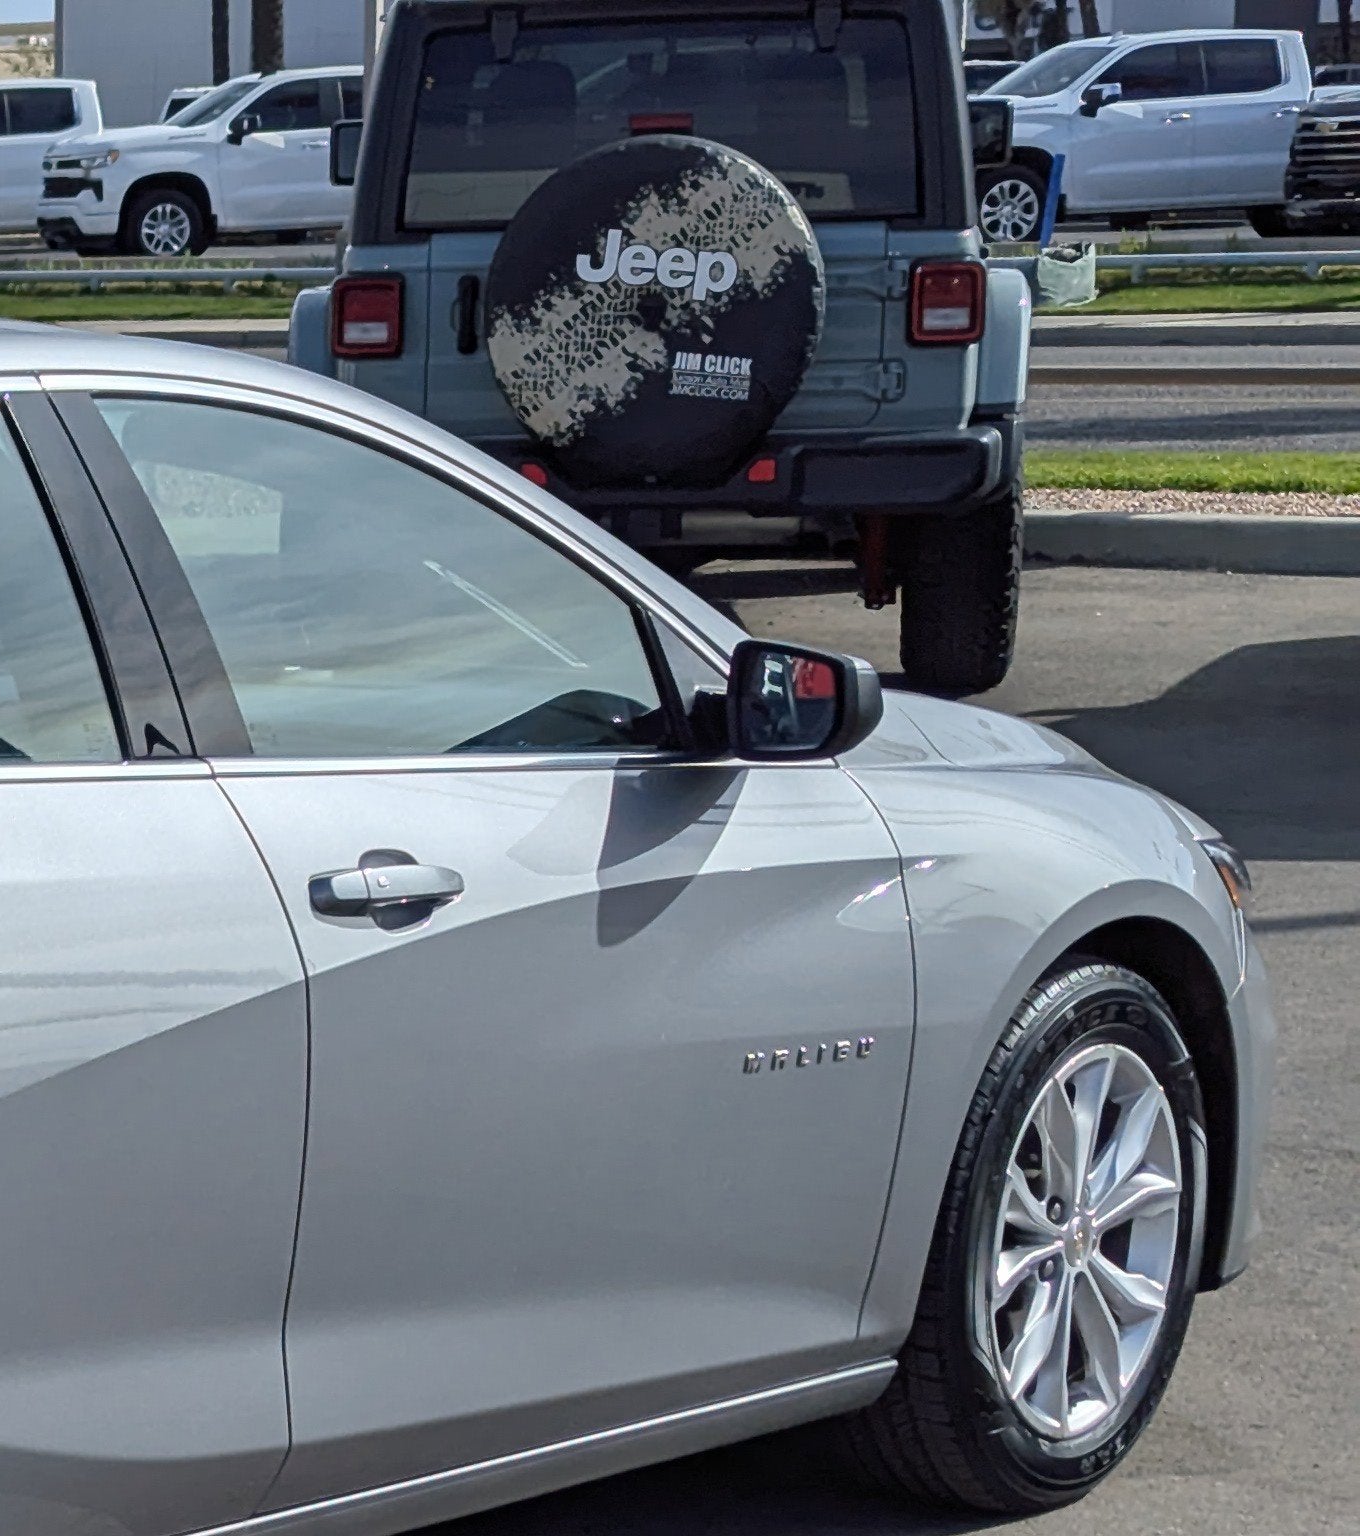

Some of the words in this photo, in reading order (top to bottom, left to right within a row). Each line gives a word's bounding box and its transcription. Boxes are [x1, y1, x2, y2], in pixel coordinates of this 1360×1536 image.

[576, 228, 738, 301] Jeep
[672, 351, 702, 371] JIM
[704, 354, 753, 376] CLICK
